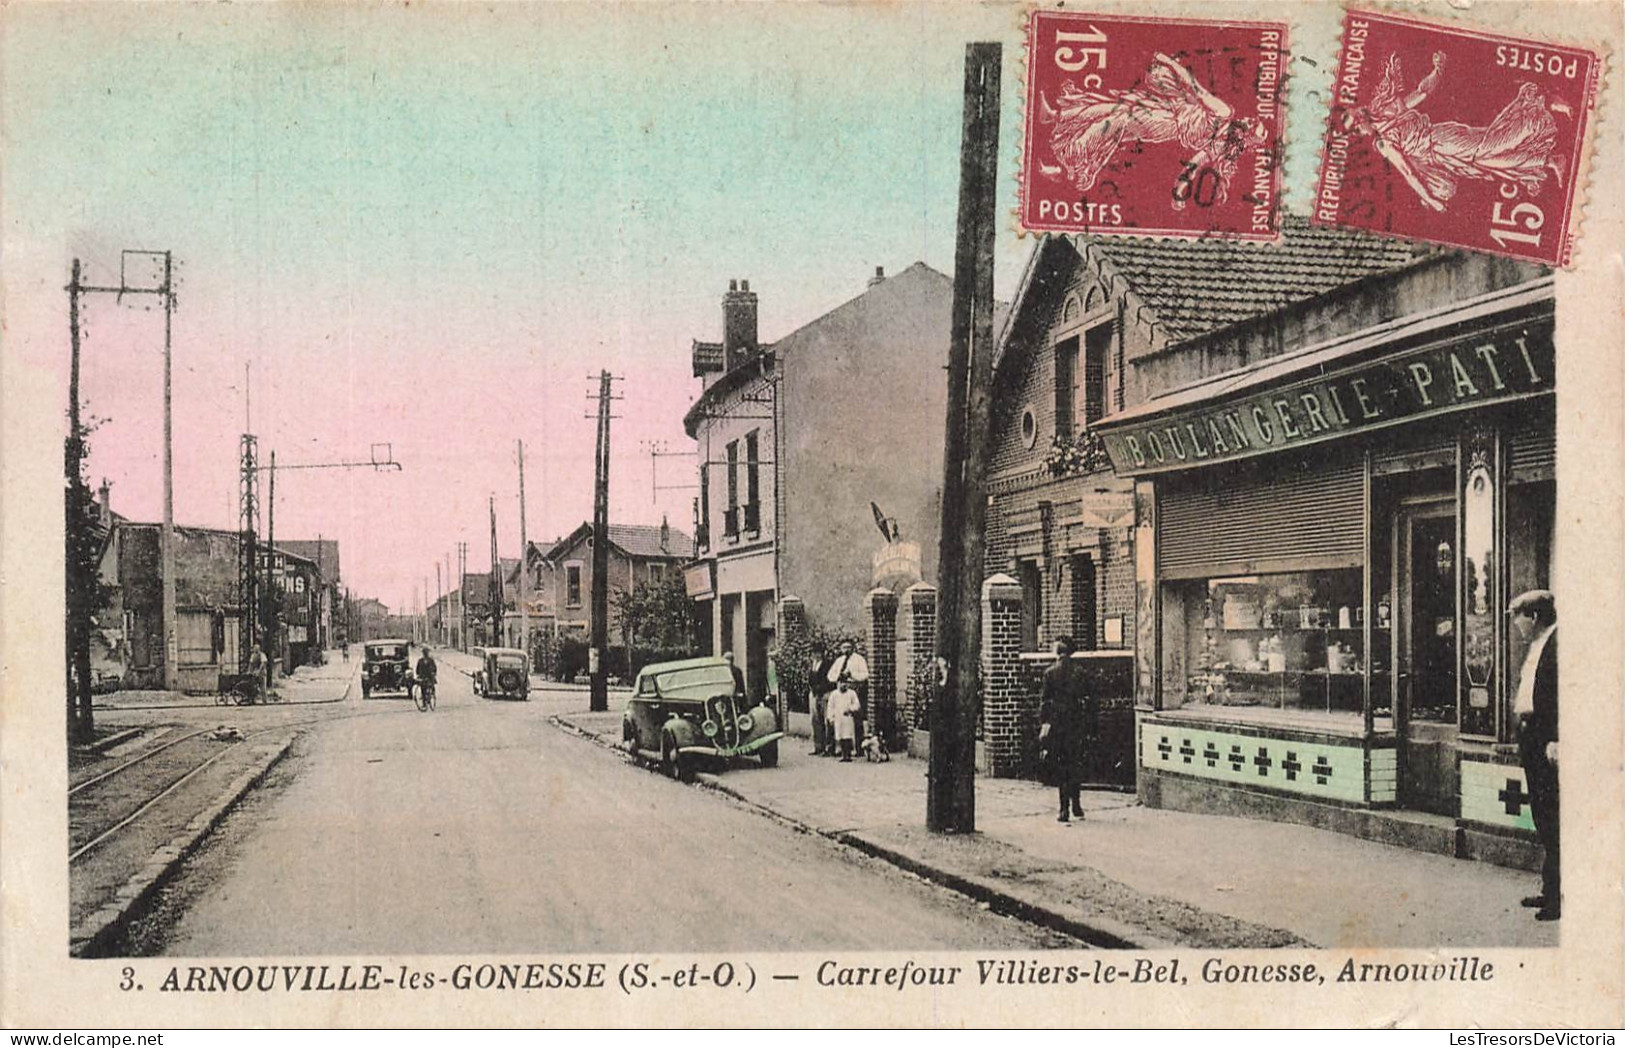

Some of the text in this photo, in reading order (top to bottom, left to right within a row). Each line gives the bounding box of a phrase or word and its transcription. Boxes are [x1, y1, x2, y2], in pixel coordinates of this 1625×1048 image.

[1496, 45, 1578, 79] POSTES
[1038, 199, 1123, 226] POSTES
[1408, 336, 1542, 406] PATI
